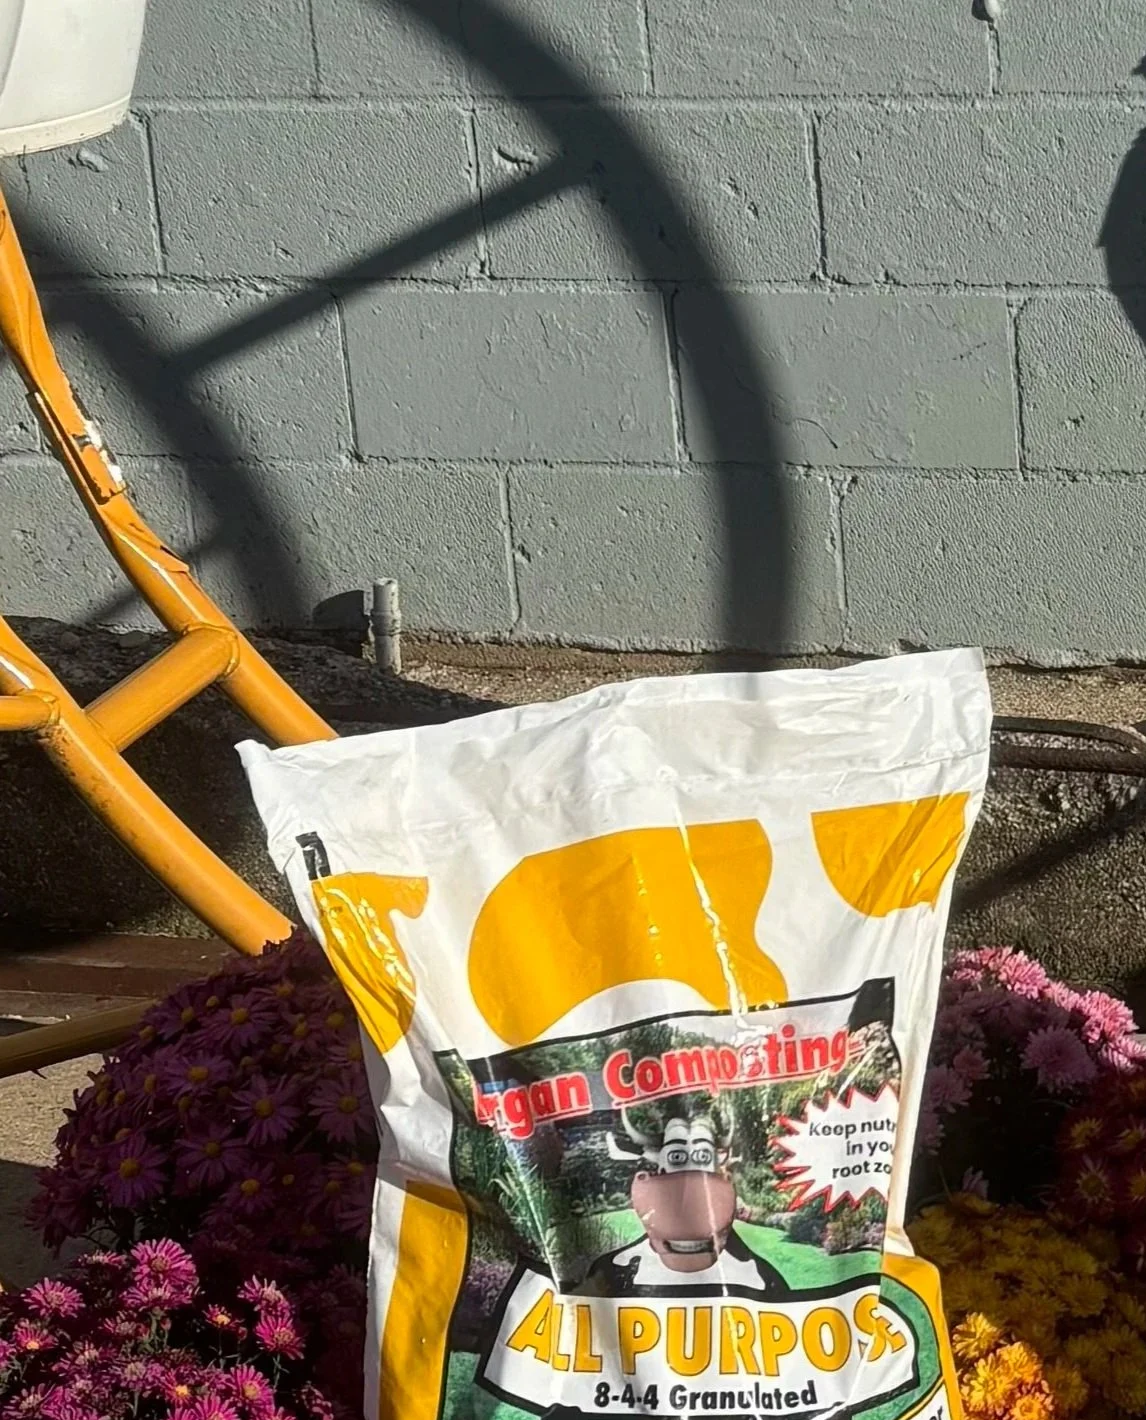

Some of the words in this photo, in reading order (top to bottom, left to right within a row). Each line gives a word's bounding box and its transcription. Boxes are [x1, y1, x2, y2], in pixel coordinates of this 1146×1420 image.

[603, 1024, 850, 1098] Composting
[809, 1121, 857, 1140] Keep
[846, 1141, 863, 1156] in
[832, 1161, 870, 1179] root
[874, 1161, 893, 1175] zo
[505, 1289, 603, 1373] ALL
[595, 1383, 659, 1409] 8-4-4
[669, 1380, 818, 1410] Granulated
